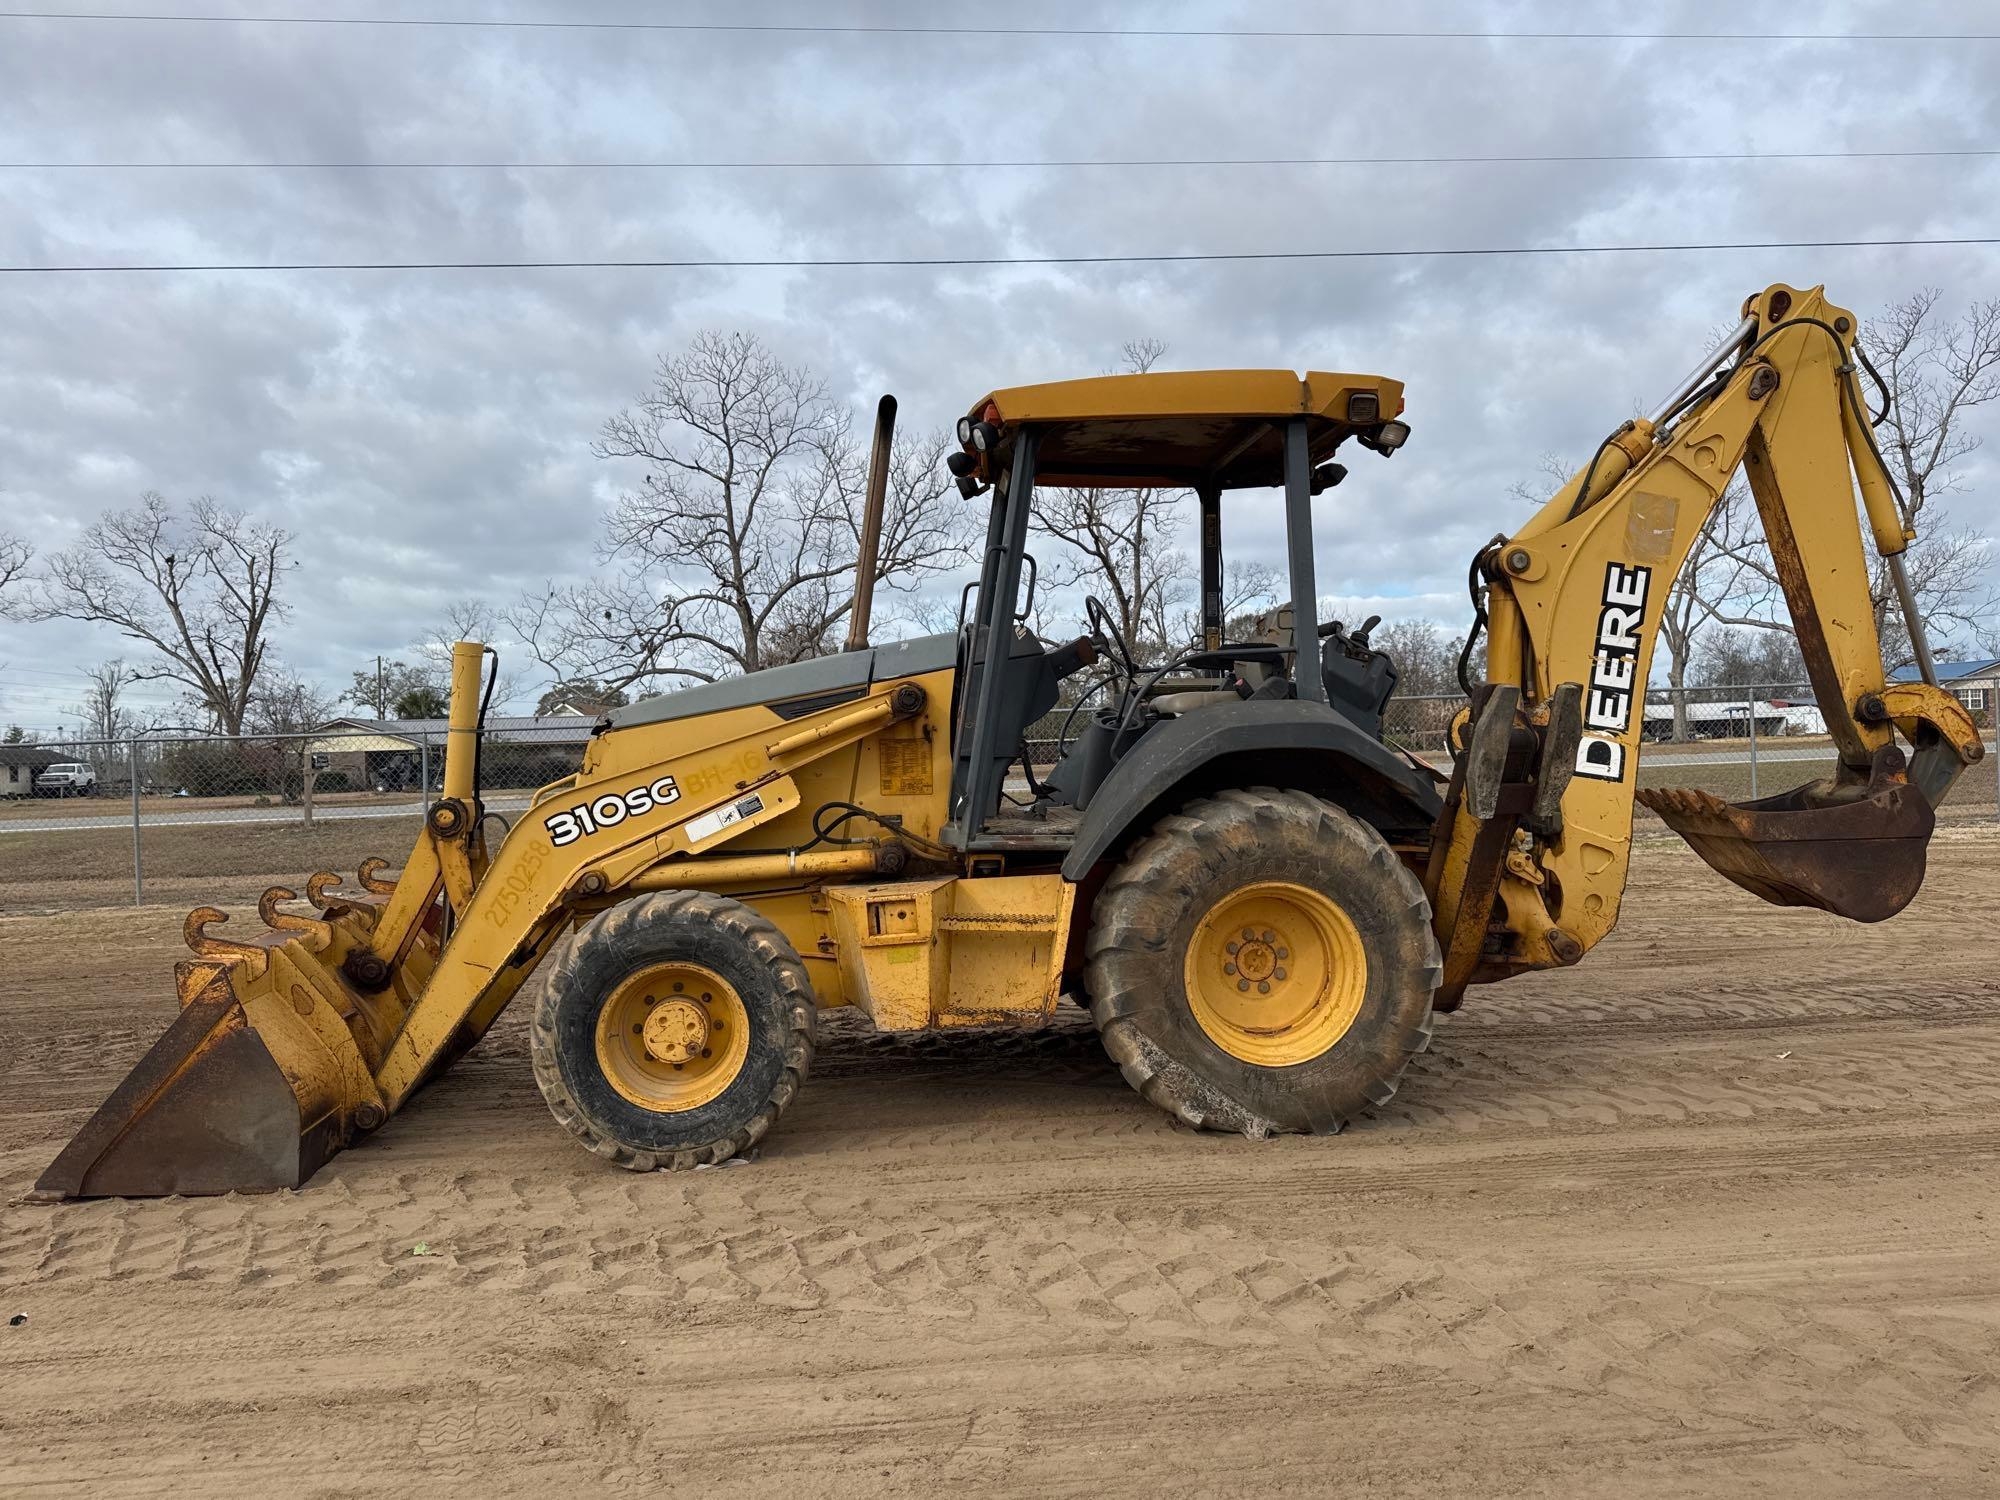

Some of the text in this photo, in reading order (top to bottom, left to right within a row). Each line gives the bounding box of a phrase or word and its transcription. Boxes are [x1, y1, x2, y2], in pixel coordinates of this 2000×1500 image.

[1574, 561, 1652, 783] DEERE
[544, 776, 681, 847] 310SG
[484, 840, 551, 928] 2750258
